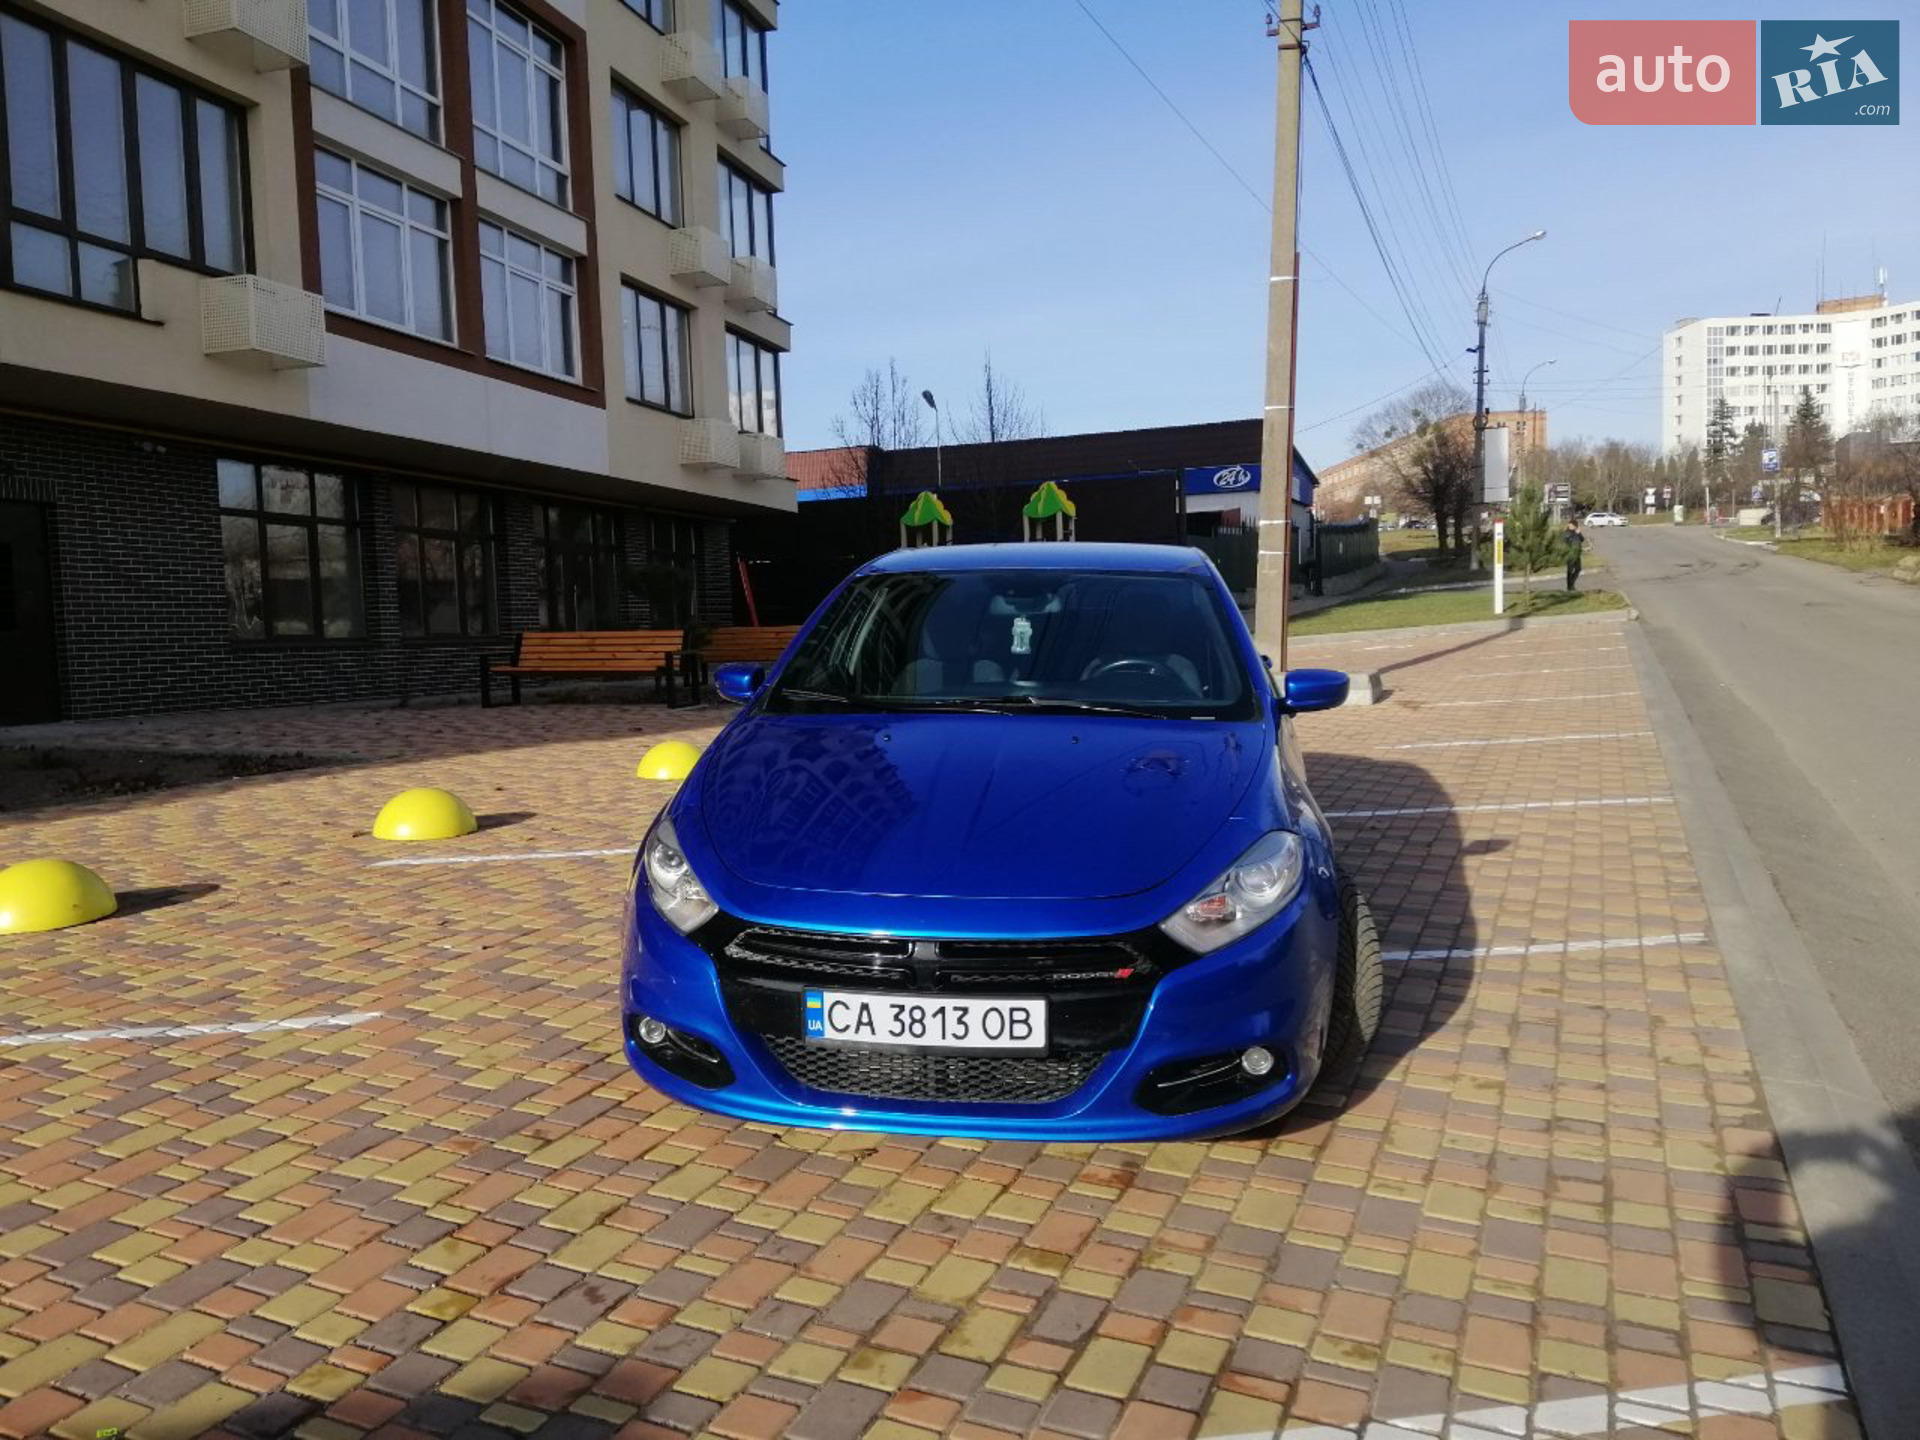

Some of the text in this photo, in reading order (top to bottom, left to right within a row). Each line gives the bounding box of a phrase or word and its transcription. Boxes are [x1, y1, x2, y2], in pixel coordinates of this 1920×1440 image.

[807, 1019, 823, 1031] UA
[827, 1000, 1033, 1040] CA 3813 OB
